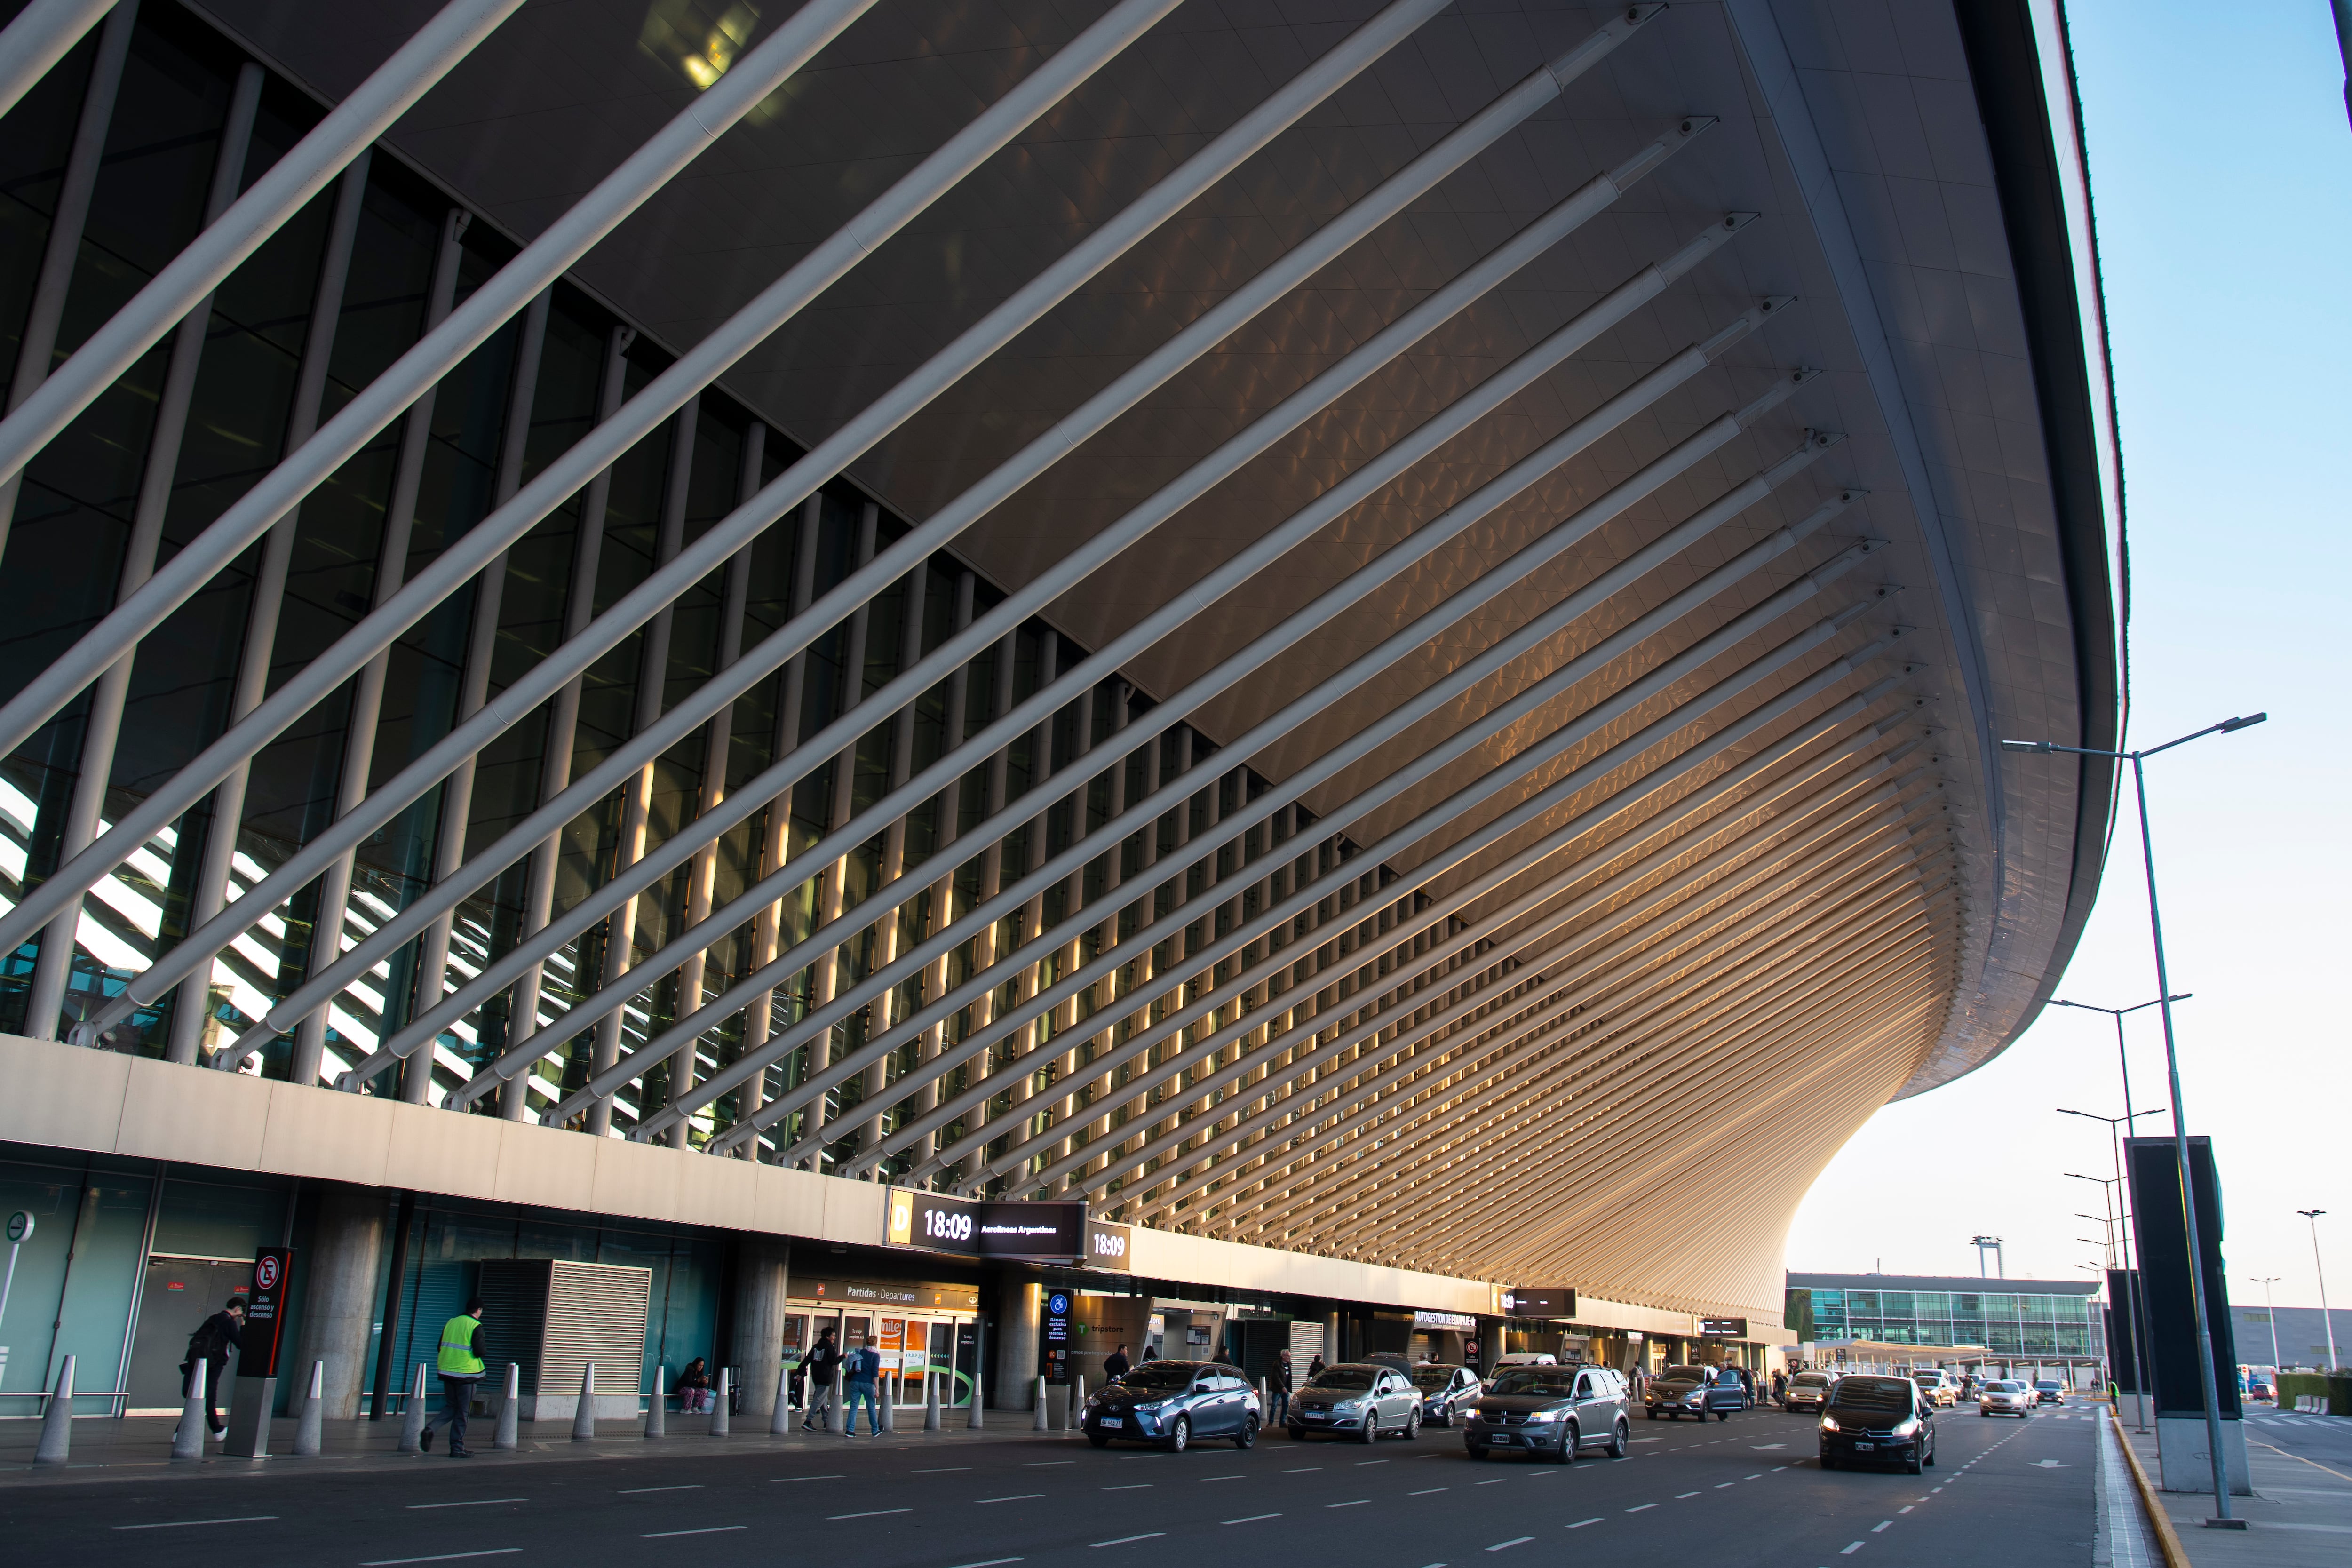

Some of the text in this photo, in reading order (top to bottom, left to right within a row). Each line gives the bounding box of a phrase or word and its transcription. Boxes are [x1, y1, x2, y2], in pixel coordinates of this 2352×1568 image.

[894, 1205, 908, 1231] D
[924, 1210, 972, 1241] 18:09
[1017, 1226, 1057, 1235] Argentinas
[1094, 1233, 1125, 1257] 18:09
[847, 1286, 915, 1302] Partidas Departures
[1500, 1294, 1514, 1309] 18:09
[1092, 1325, 1124, 1334] tripstore
